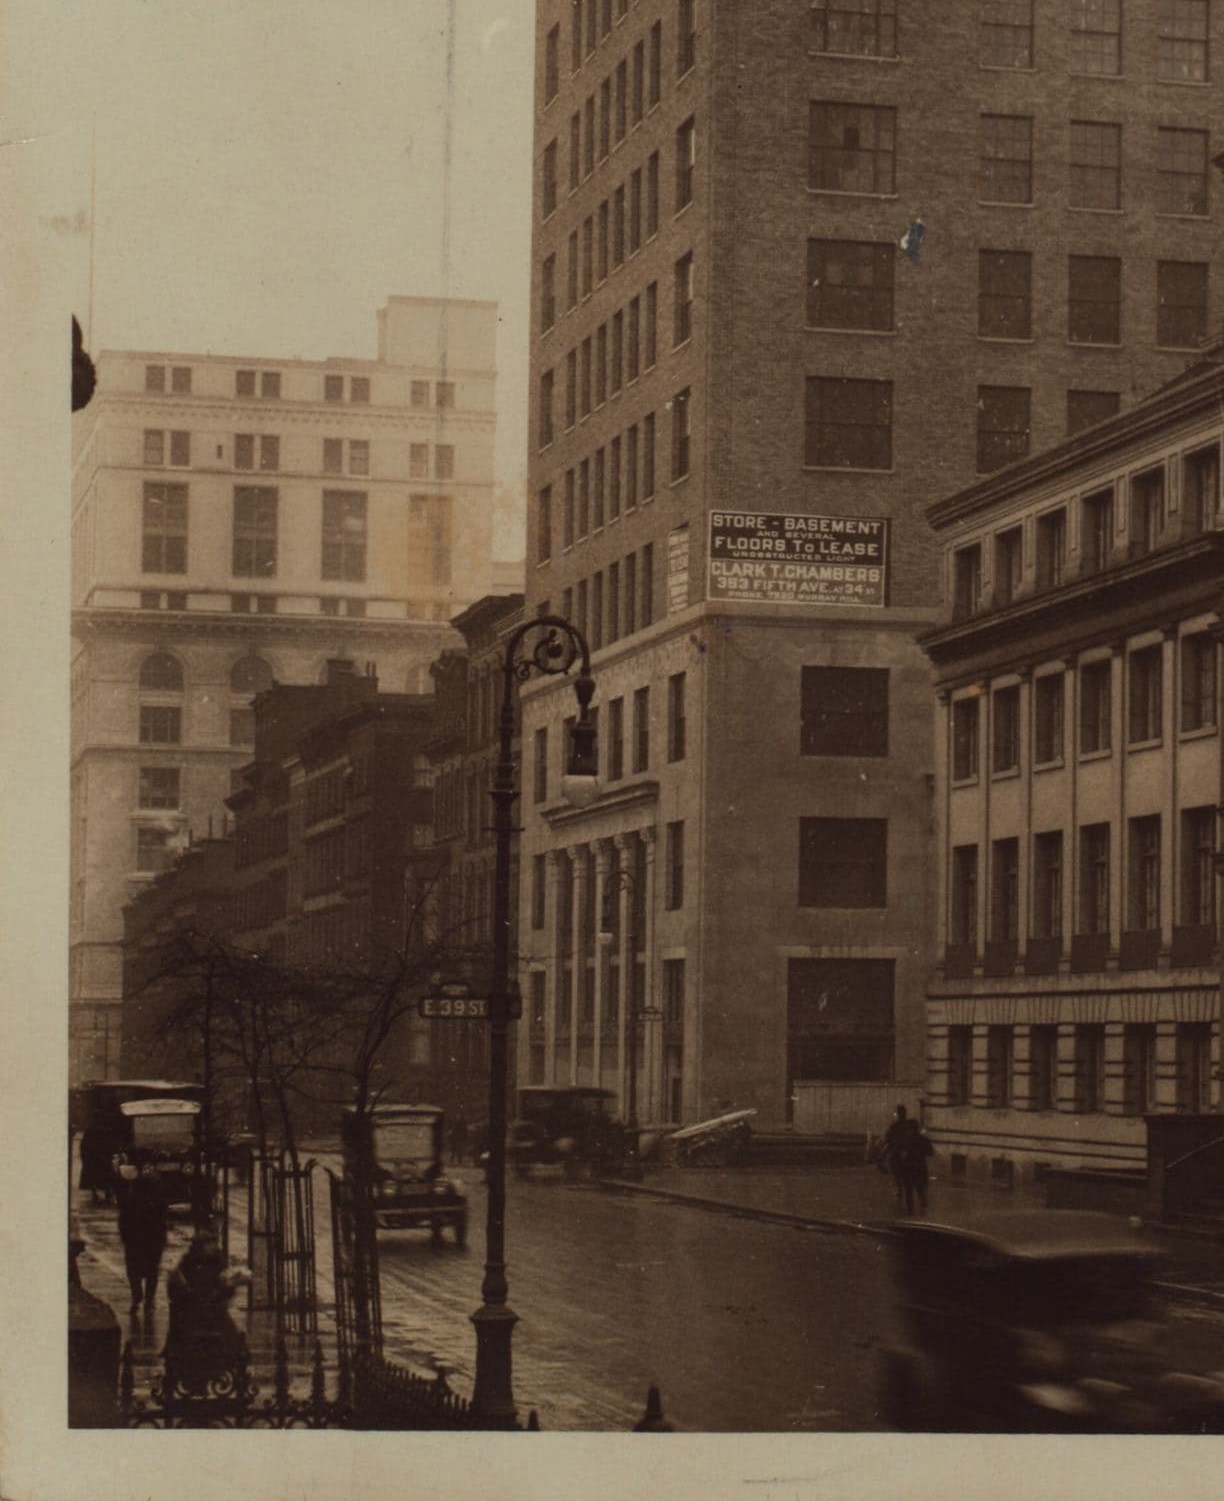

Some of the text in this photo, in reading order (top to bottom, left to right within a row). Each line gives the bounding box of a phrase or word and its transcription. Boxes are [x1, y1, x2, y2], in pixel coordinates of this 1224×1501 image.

[713, 514, 767, 529] STORE
[784, 517, 881, 534] BASEMENT
[785, 531, 836, 540] SEVERAL
[715, 536, 786, 551] FLOORS
[820, 541, 879, 556] LEASE
[711, 561, 766, 577] CLARK
[753, 579, 796, 591] FIFTH
[440, 999, 465, 1016] 39
